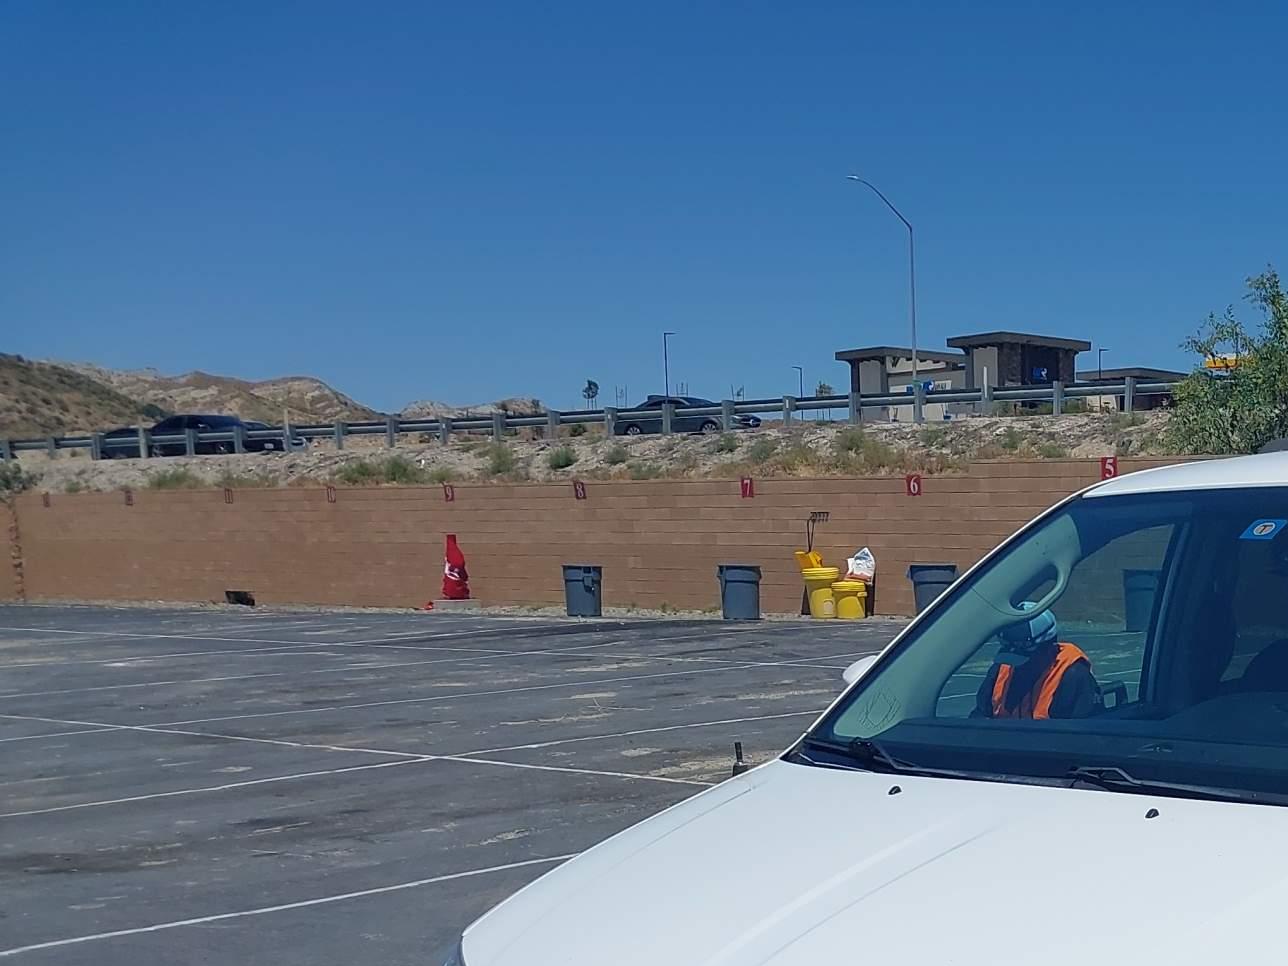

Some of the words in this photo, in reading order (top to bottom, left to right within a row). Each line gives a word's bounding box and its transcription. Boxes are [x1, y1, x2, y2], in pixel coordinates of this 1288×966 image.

[1105, 458, 1115, 478] 5
[445, 485, 453, 500] 9
[576, 483, 584, 498] 8
[742, 479, 751, 497] 7
[909, 476, 919, 494] 6
